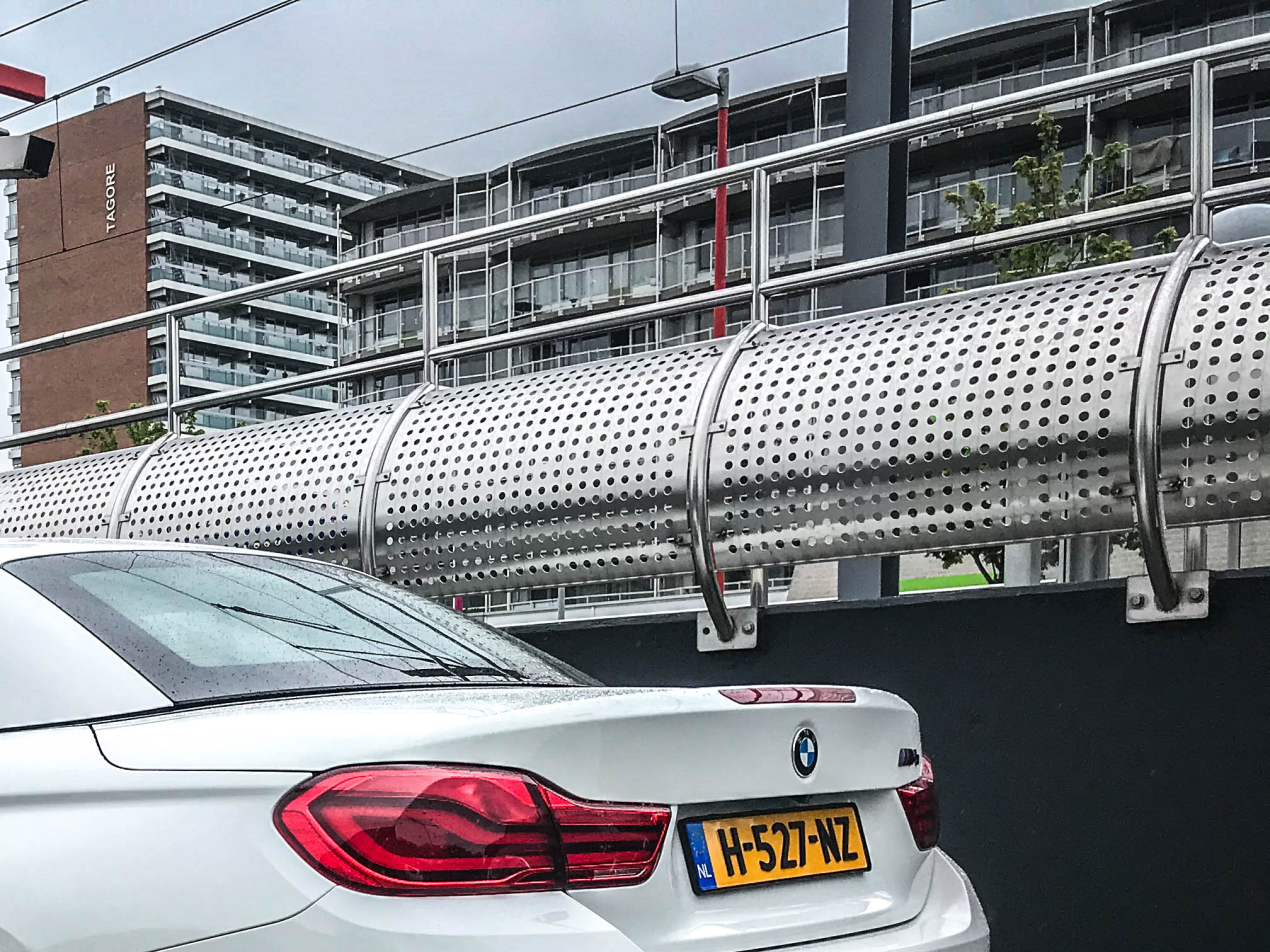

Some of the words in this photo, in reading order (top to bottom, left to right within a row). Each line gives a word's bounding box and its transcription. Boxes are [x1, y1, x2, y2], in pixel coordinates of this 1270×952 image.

[105, 162, 116, 234] TAGORE
[696, 863, 713, 879] NL
[717, 816, 859, 877] H-527-NZ
